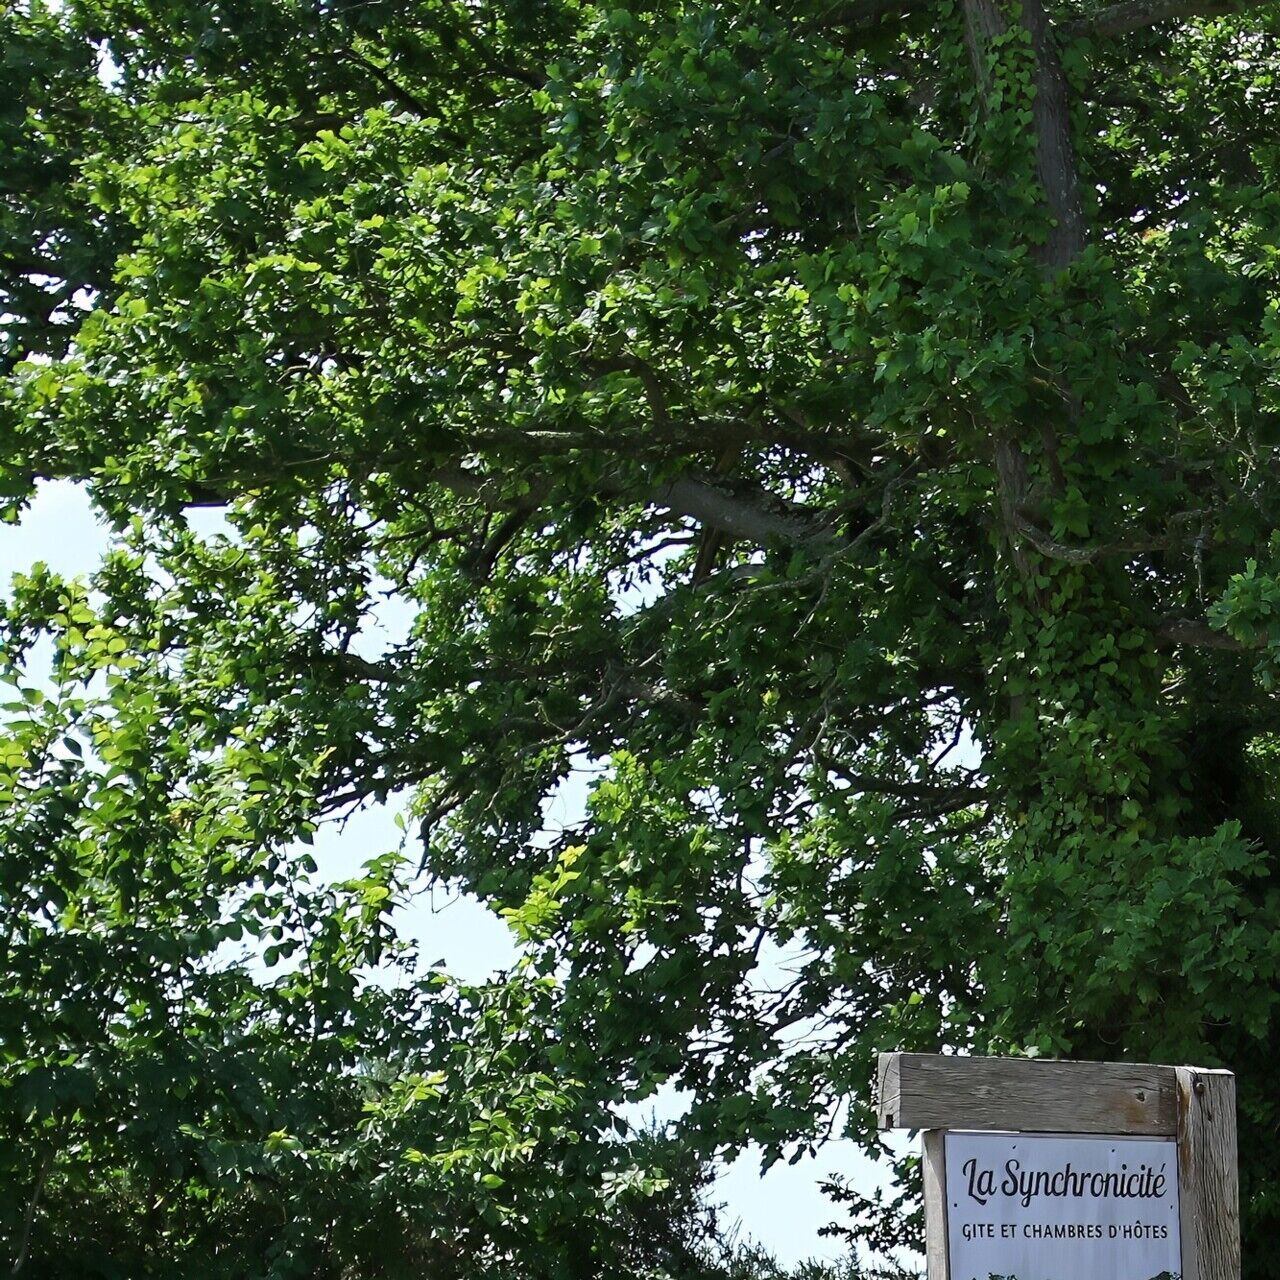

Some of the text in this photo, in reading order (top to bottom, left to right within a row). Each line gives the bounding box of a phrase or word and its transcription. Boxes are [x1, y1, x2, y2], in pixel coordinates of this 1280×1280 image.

[962, 1158, 1168, 1207] La Synchronicité
[962, 1220, 1168, 1241] GITE ET CHAMBRES D'HÔTES
